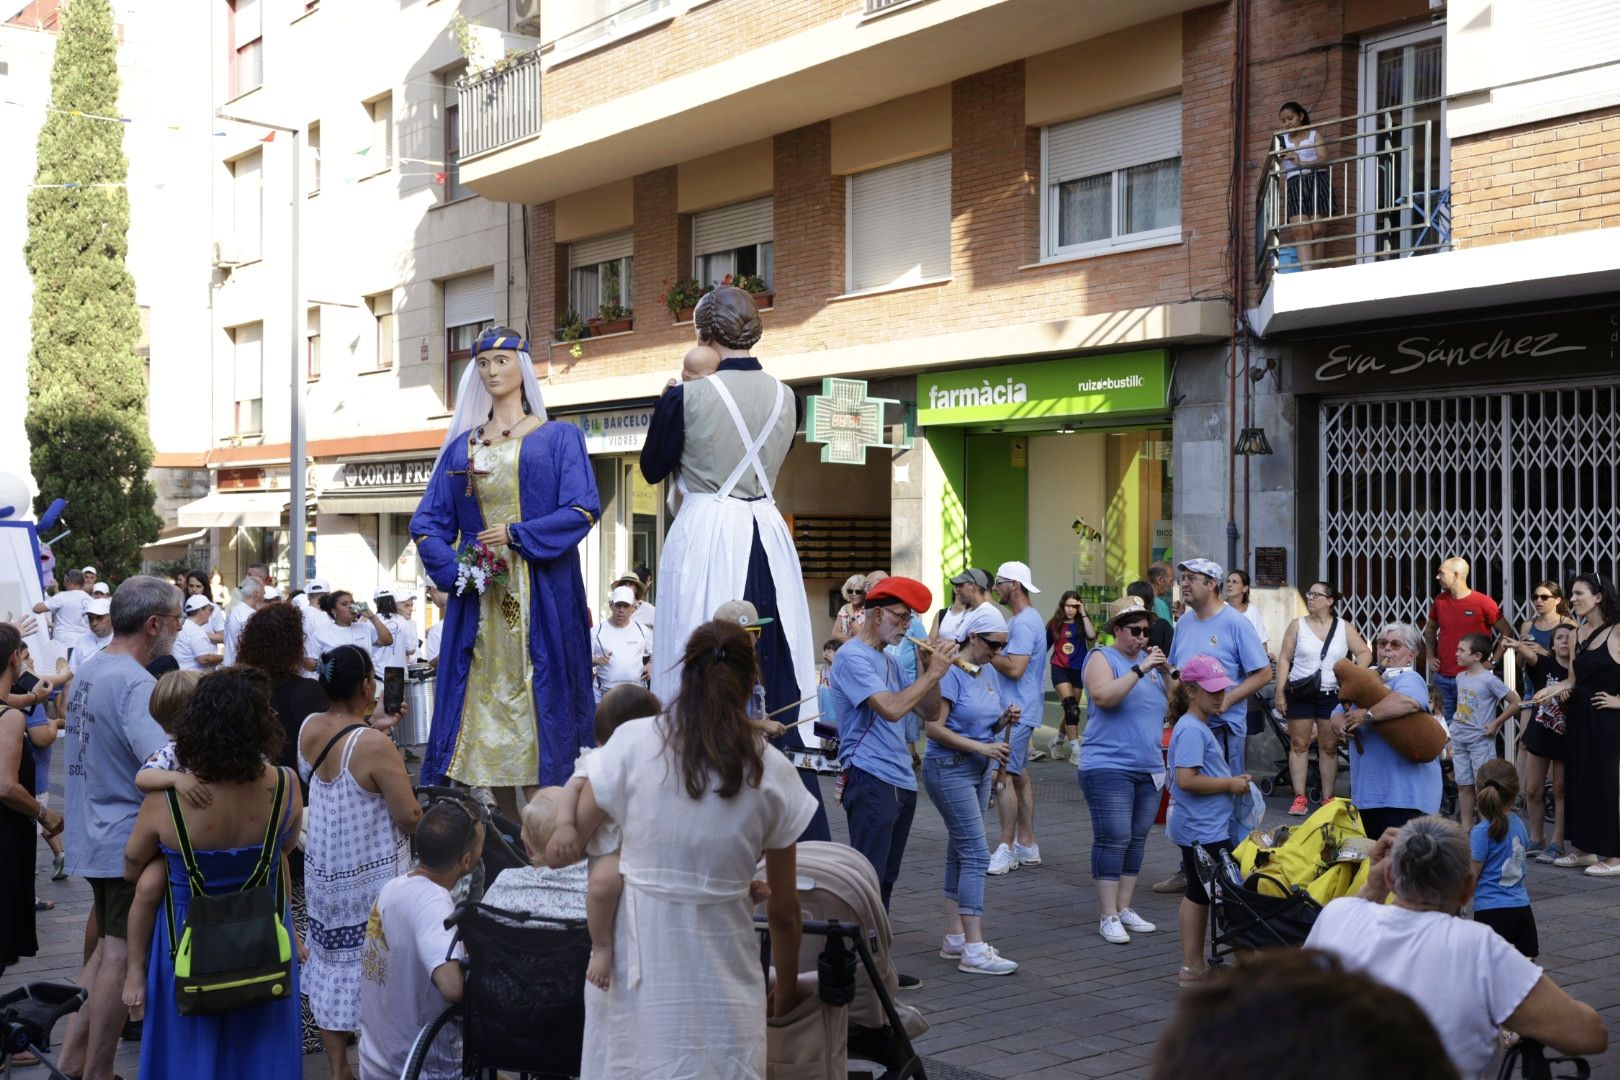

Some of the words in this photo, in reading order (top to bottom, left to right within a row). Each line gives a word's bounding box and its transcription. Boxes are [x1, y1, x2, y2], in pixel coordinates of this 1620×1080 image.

[1315, 345, 1386, 381] Eva
[1390, 330, 1586, 374] Sánchez
[929, 377, 1027, 409] farmàcia
[584, 418, 601, 431] GIL
[609, 436, 638, 446] VIDRES
[358, 464, 402, 486] CORTE
